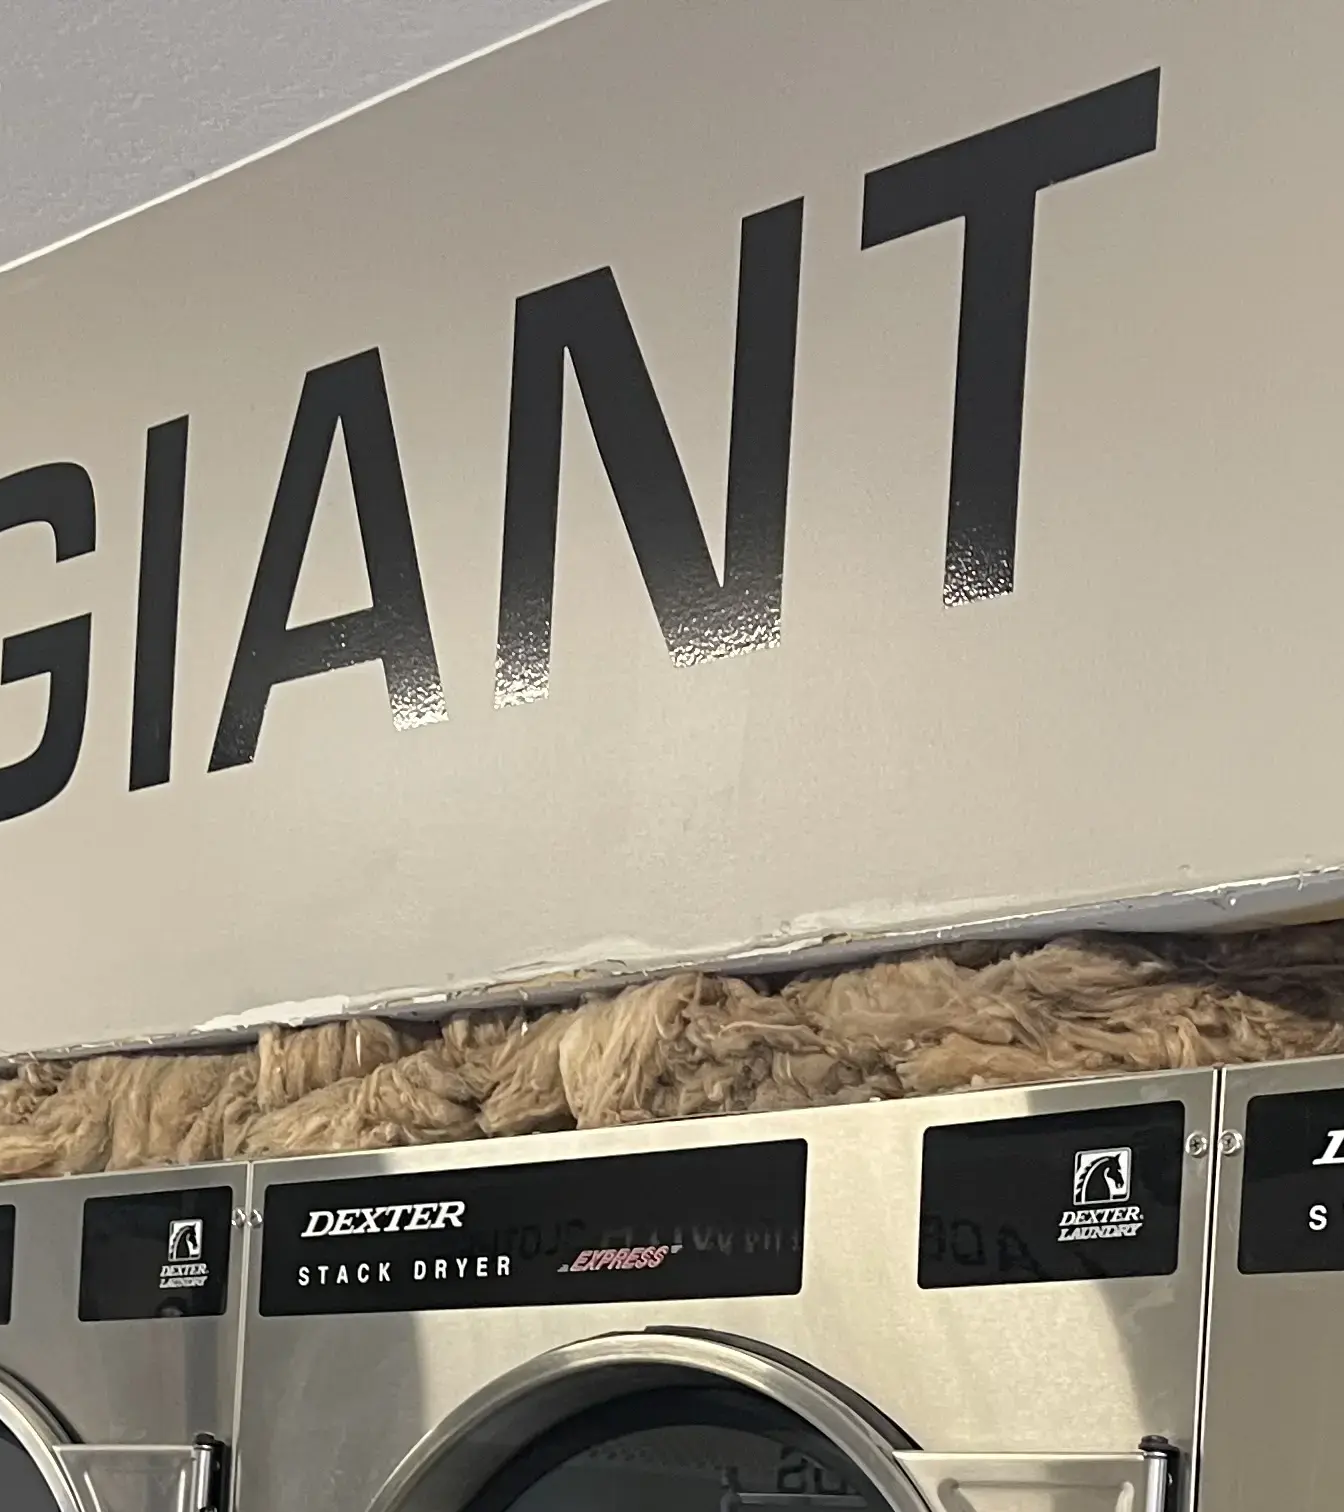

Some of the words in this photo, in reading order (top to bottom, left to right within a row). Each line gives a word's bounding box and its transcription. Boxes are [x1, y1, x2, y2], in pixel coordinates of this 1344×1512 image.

[299, 1200, 466, 1239] DEXTER
[1058, 1205, 1141, 1227] DEXTER
[1057, 1222, 1143, 1242] LAUNDRY
[297, 1261, 393, 1287] STACK
[413, 1254, 513, 1281] DRYER
[569, 1245, 669, 1271] EXPRESS
